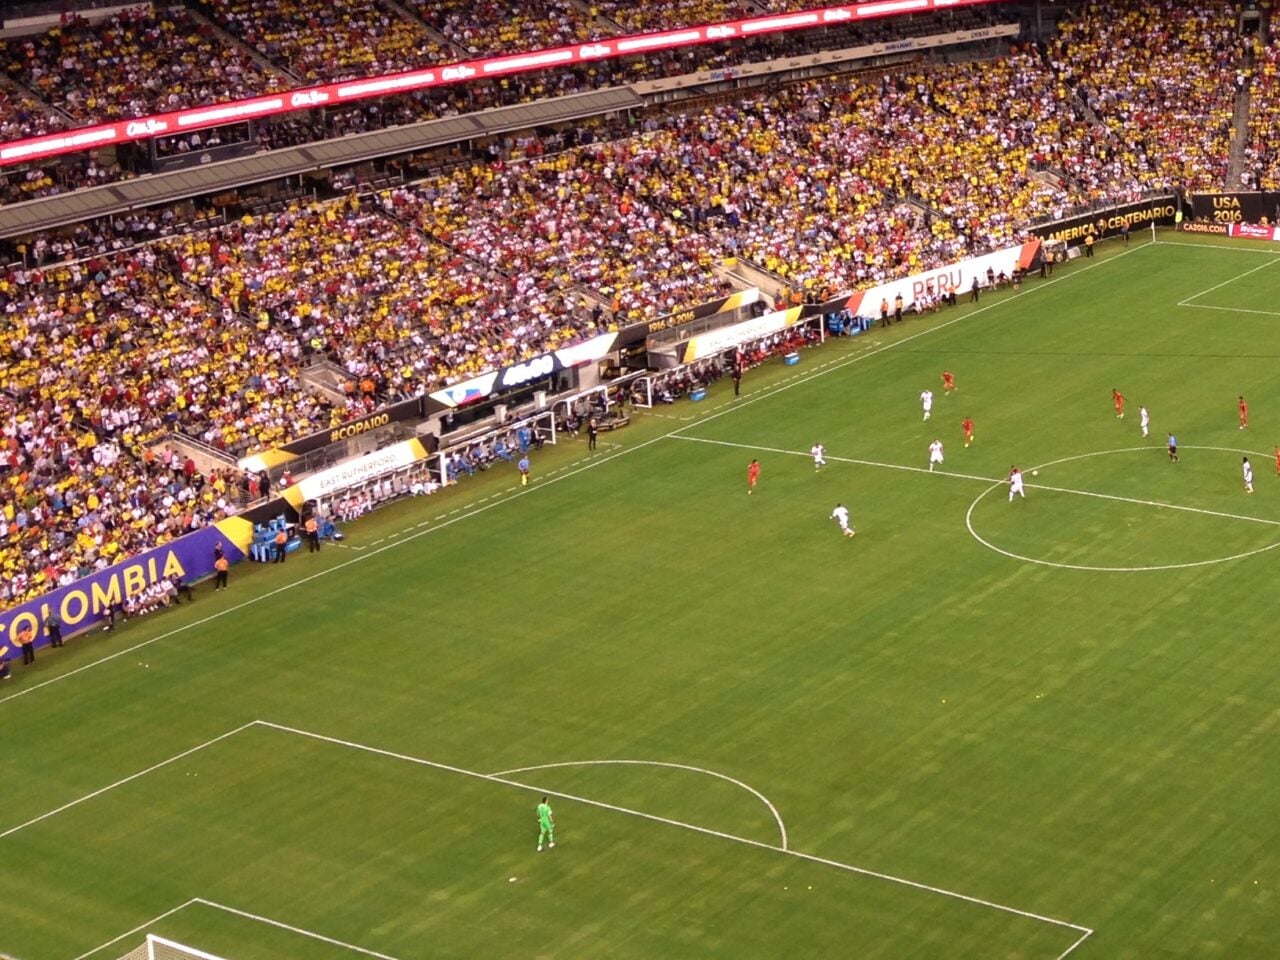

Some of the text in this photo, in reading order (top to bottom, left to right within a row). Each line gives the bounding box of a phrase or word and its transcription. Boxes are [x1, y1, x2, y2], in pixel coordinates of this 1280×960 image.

[1213, 196, 1241, 209] USA
[1049, 205, 1176, 242] AMERICA CENTENARIO
[1183, 223, 1227, 233] CA2016.COM
[1213, 210, 1242, 222] 2016
[912, 268, 962, 300] PERU
[649, 311, 695, 332] 1916 2016
[331, 413, 389, 442] #COPA100
[320, 474, 340, 489] EAST
[342, 454, 397, 480] RUTHERFORD
